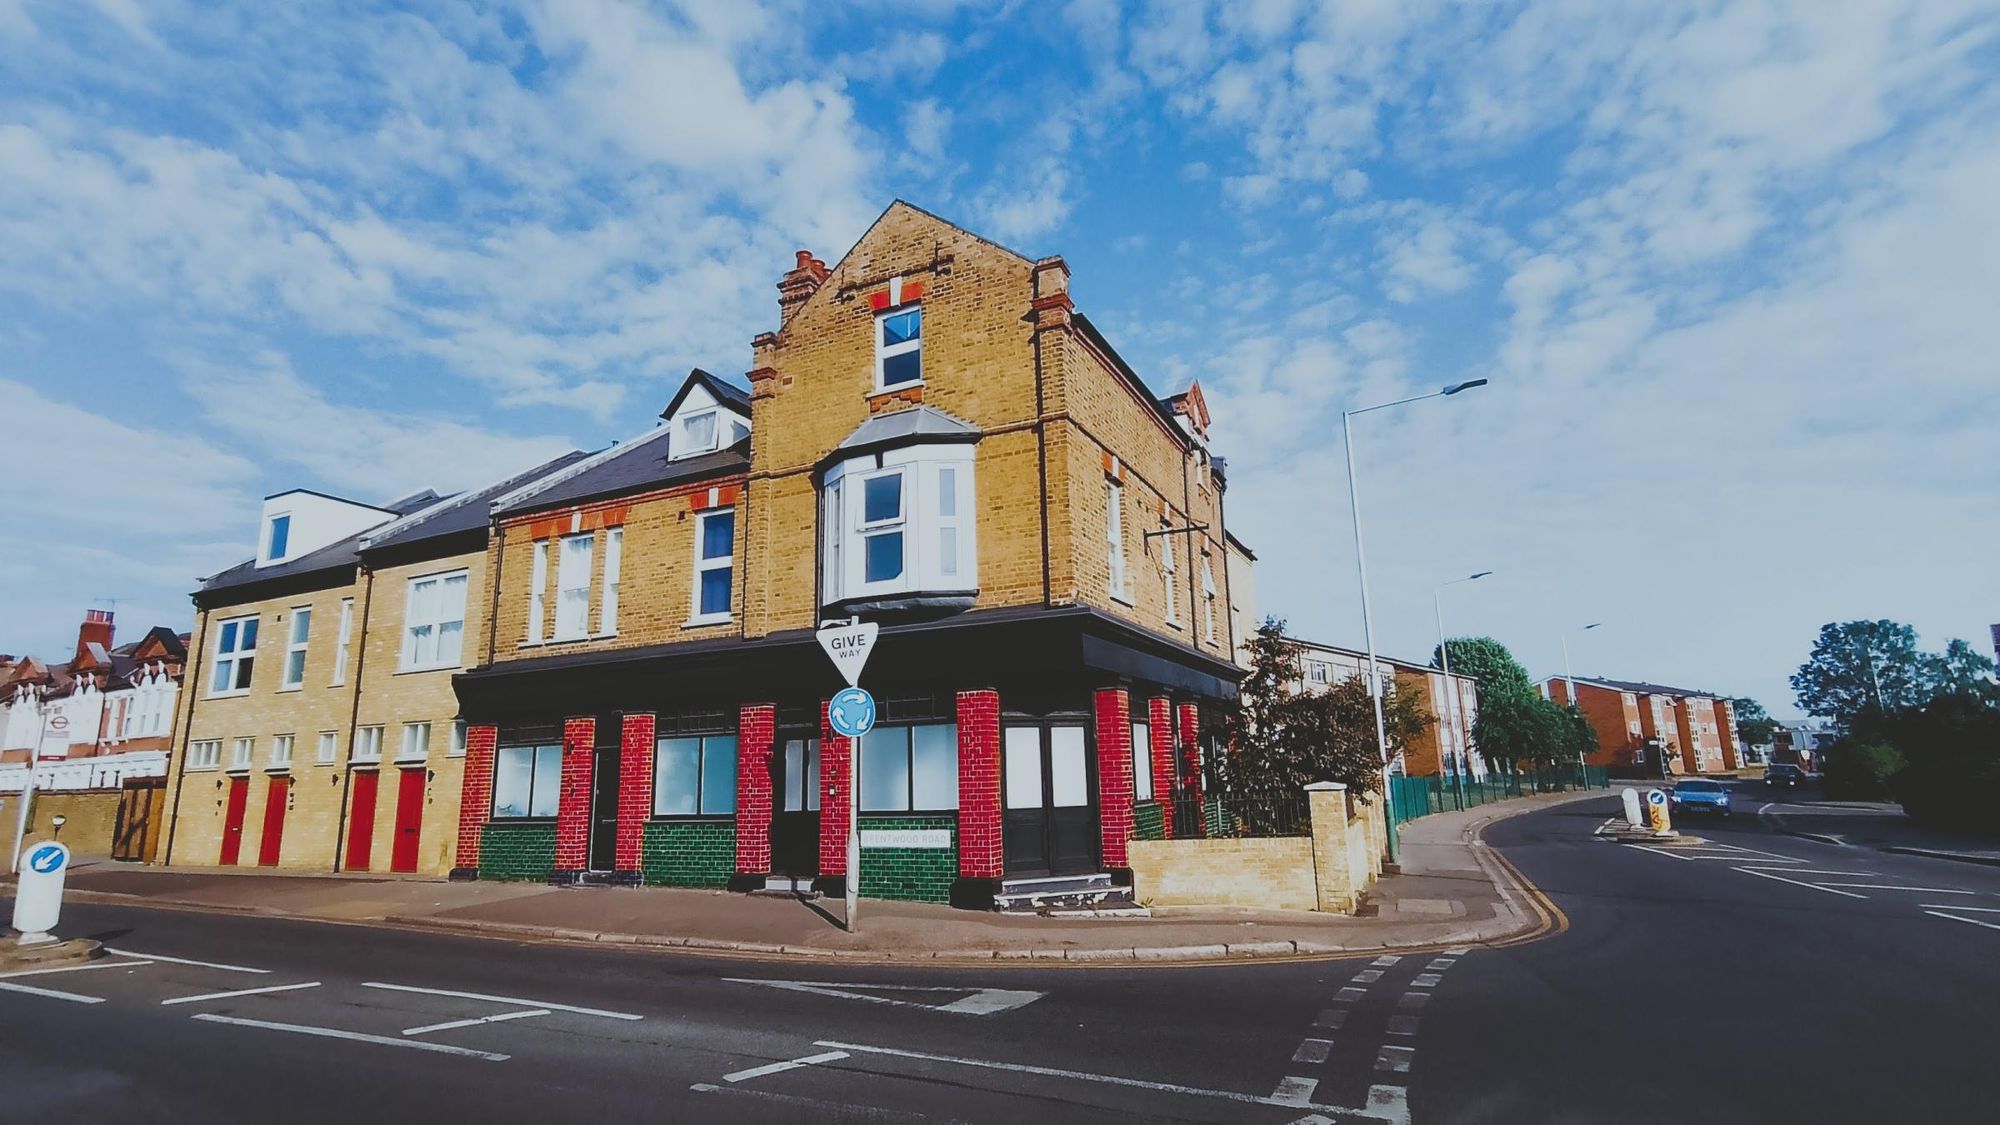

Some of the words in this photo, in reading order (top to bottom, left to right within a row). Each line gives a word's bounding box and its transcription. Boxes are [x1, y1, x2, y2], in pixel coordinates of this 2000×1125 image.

[831, 634, 866, 650] GIVE
[839, 649, 861, 659] WAY
[922, 834, 947, 844] ROAD
